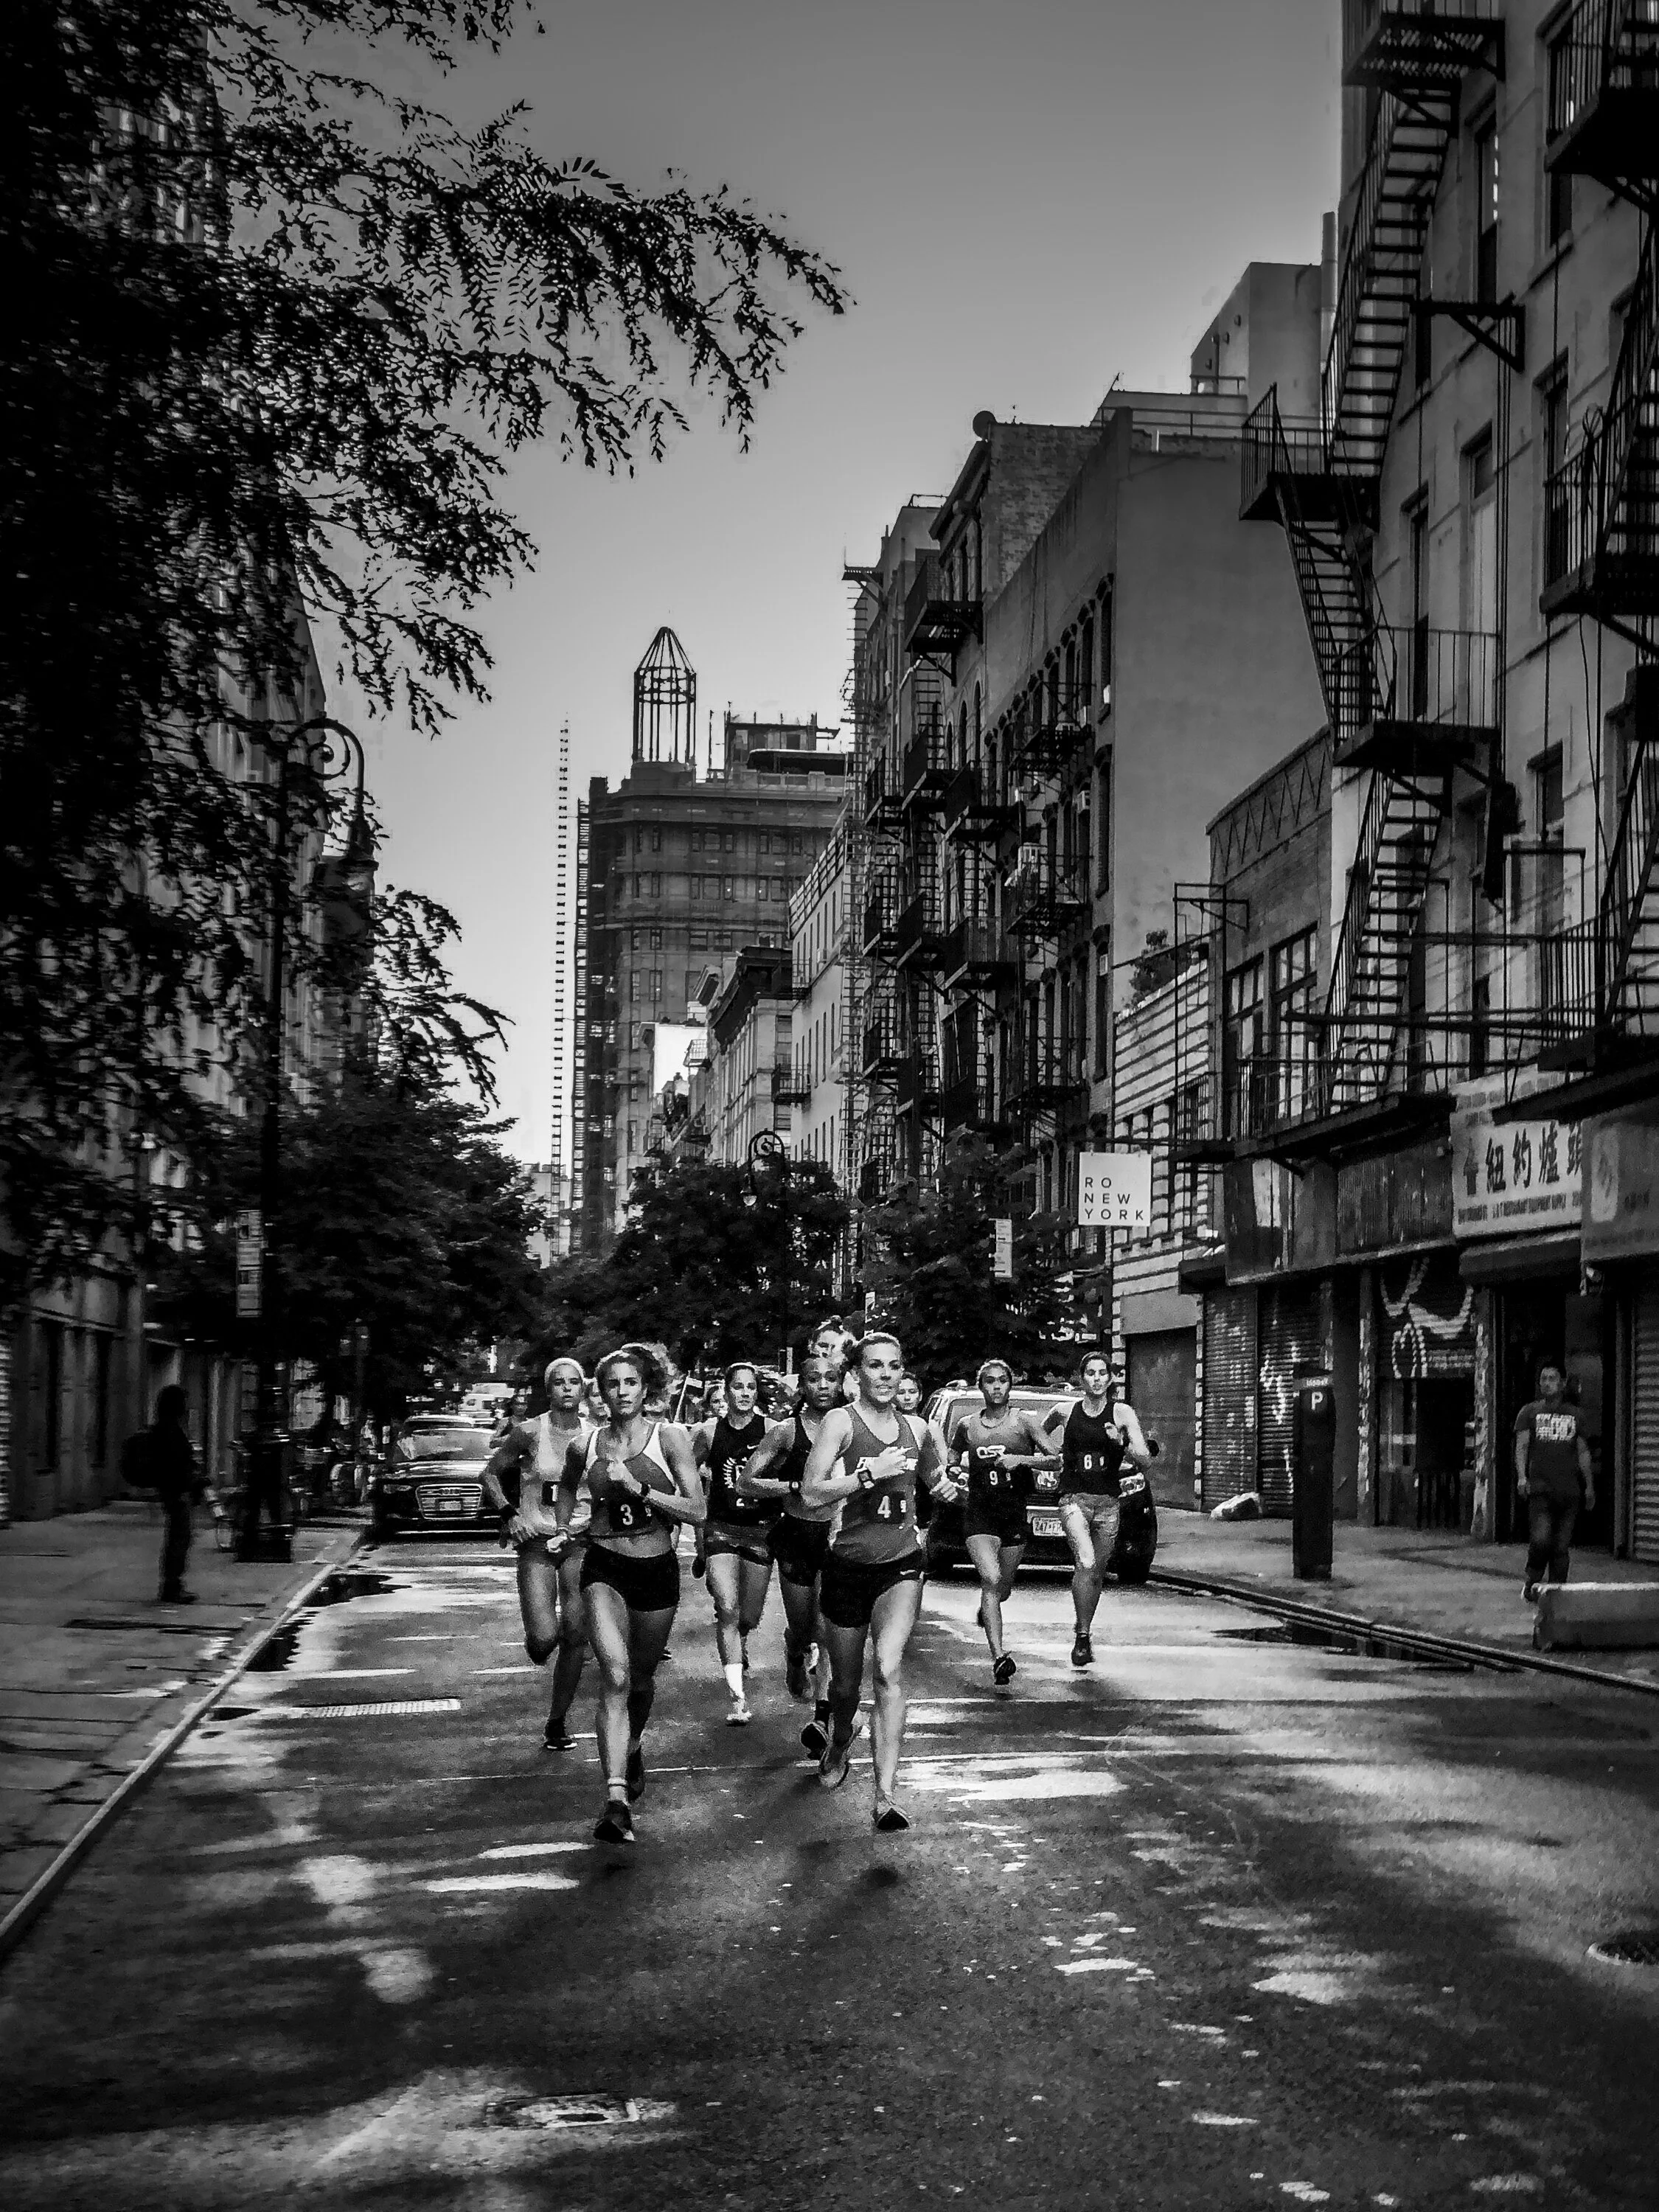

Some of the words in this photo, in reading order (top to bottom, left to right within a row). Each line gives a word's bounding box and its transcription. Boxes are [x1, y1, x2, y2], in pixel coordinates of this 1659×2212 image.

[1085, 1178, 1111, 1188] RO
[1085, 1193, 1130, 1204] NEW
[1085, 1209, 1143, 1220] YORK
[1311, 1391, 1324, 1411] P
[990, 1470, 998, 1486] 9
[620, 1503, 633, 1526] 3
[877, 1495, 892, 1518] 4
